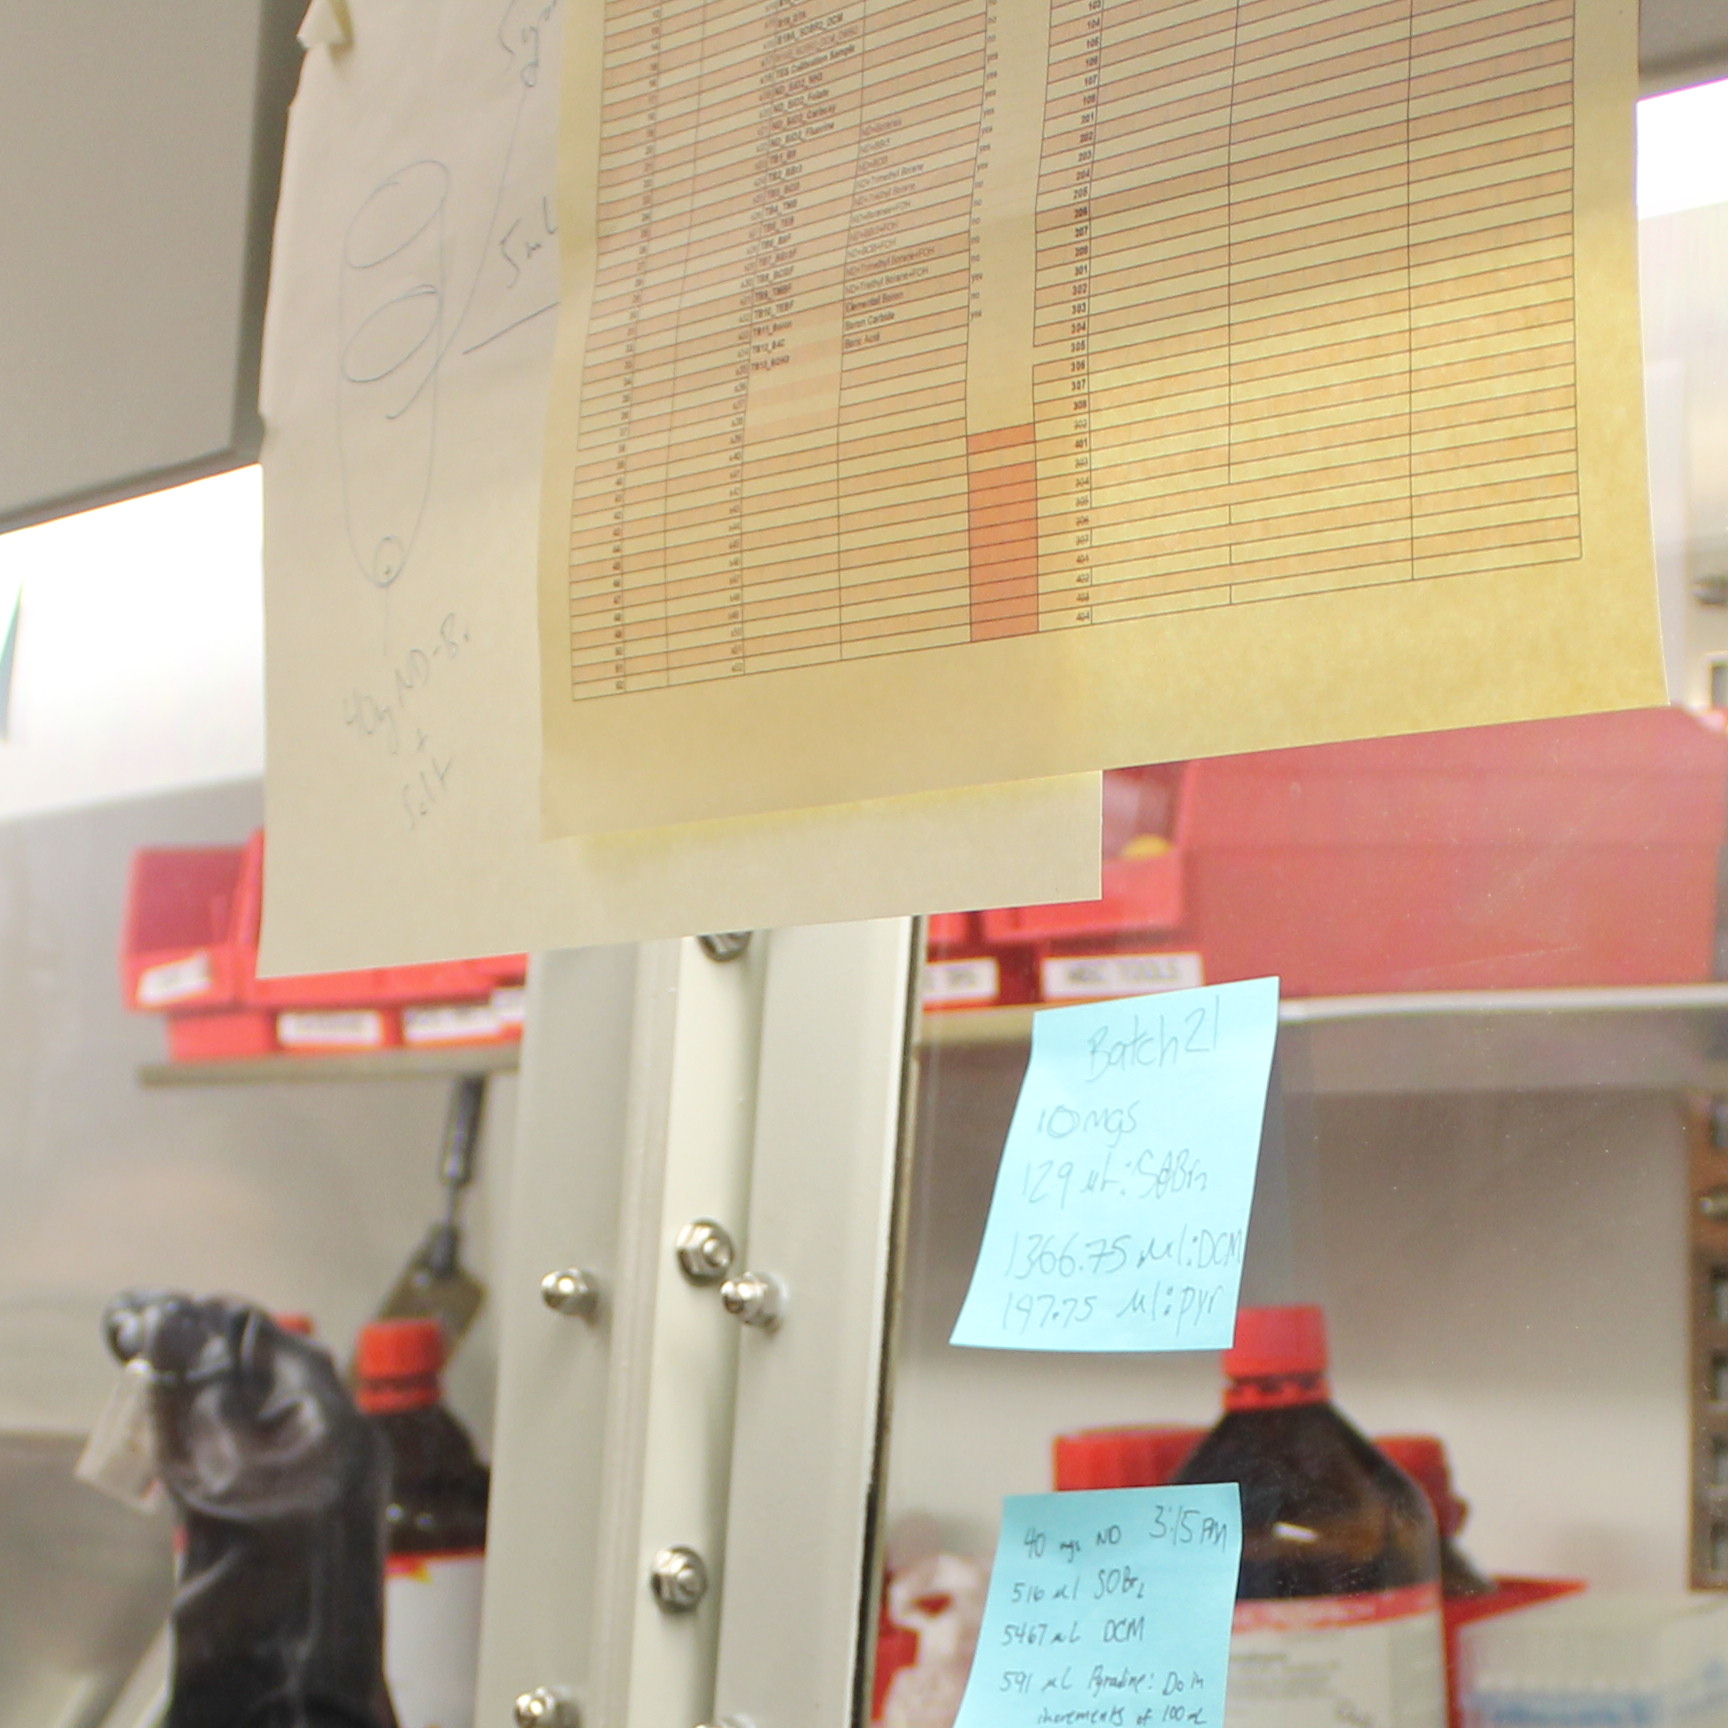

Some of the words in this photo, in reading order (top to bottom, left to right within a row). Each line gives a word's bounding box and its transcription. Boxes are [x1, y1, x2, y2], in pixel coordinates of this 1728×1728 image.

[1084, 74, 1098, 86] 107
[1075, 264, 1088, 276] 301
[1072, 283, 1087, 295] 302
[1072, 302, 1087, 315] 303
[1071, 322, 1086, 334] 304
[1071, 340, 1086, 353] 305
[1071, 360, 1086, 372] 306
[1071, 379, 1086, 391] 307
[1085, 1014, 1178, 1084] Batch
[1004, 1224, 1132, 1280] 1366.75
[1023, 1529, 1047, 1560] 40
[1000, 1623, 1049, 1648] 5467
[1102, 1615, 1146, 1644] DCM
[998, 1668, 1032, 1694] 591
[1161, 1671, 1186, 1698] Do
[1135, 1707, 1154, 1727] of
